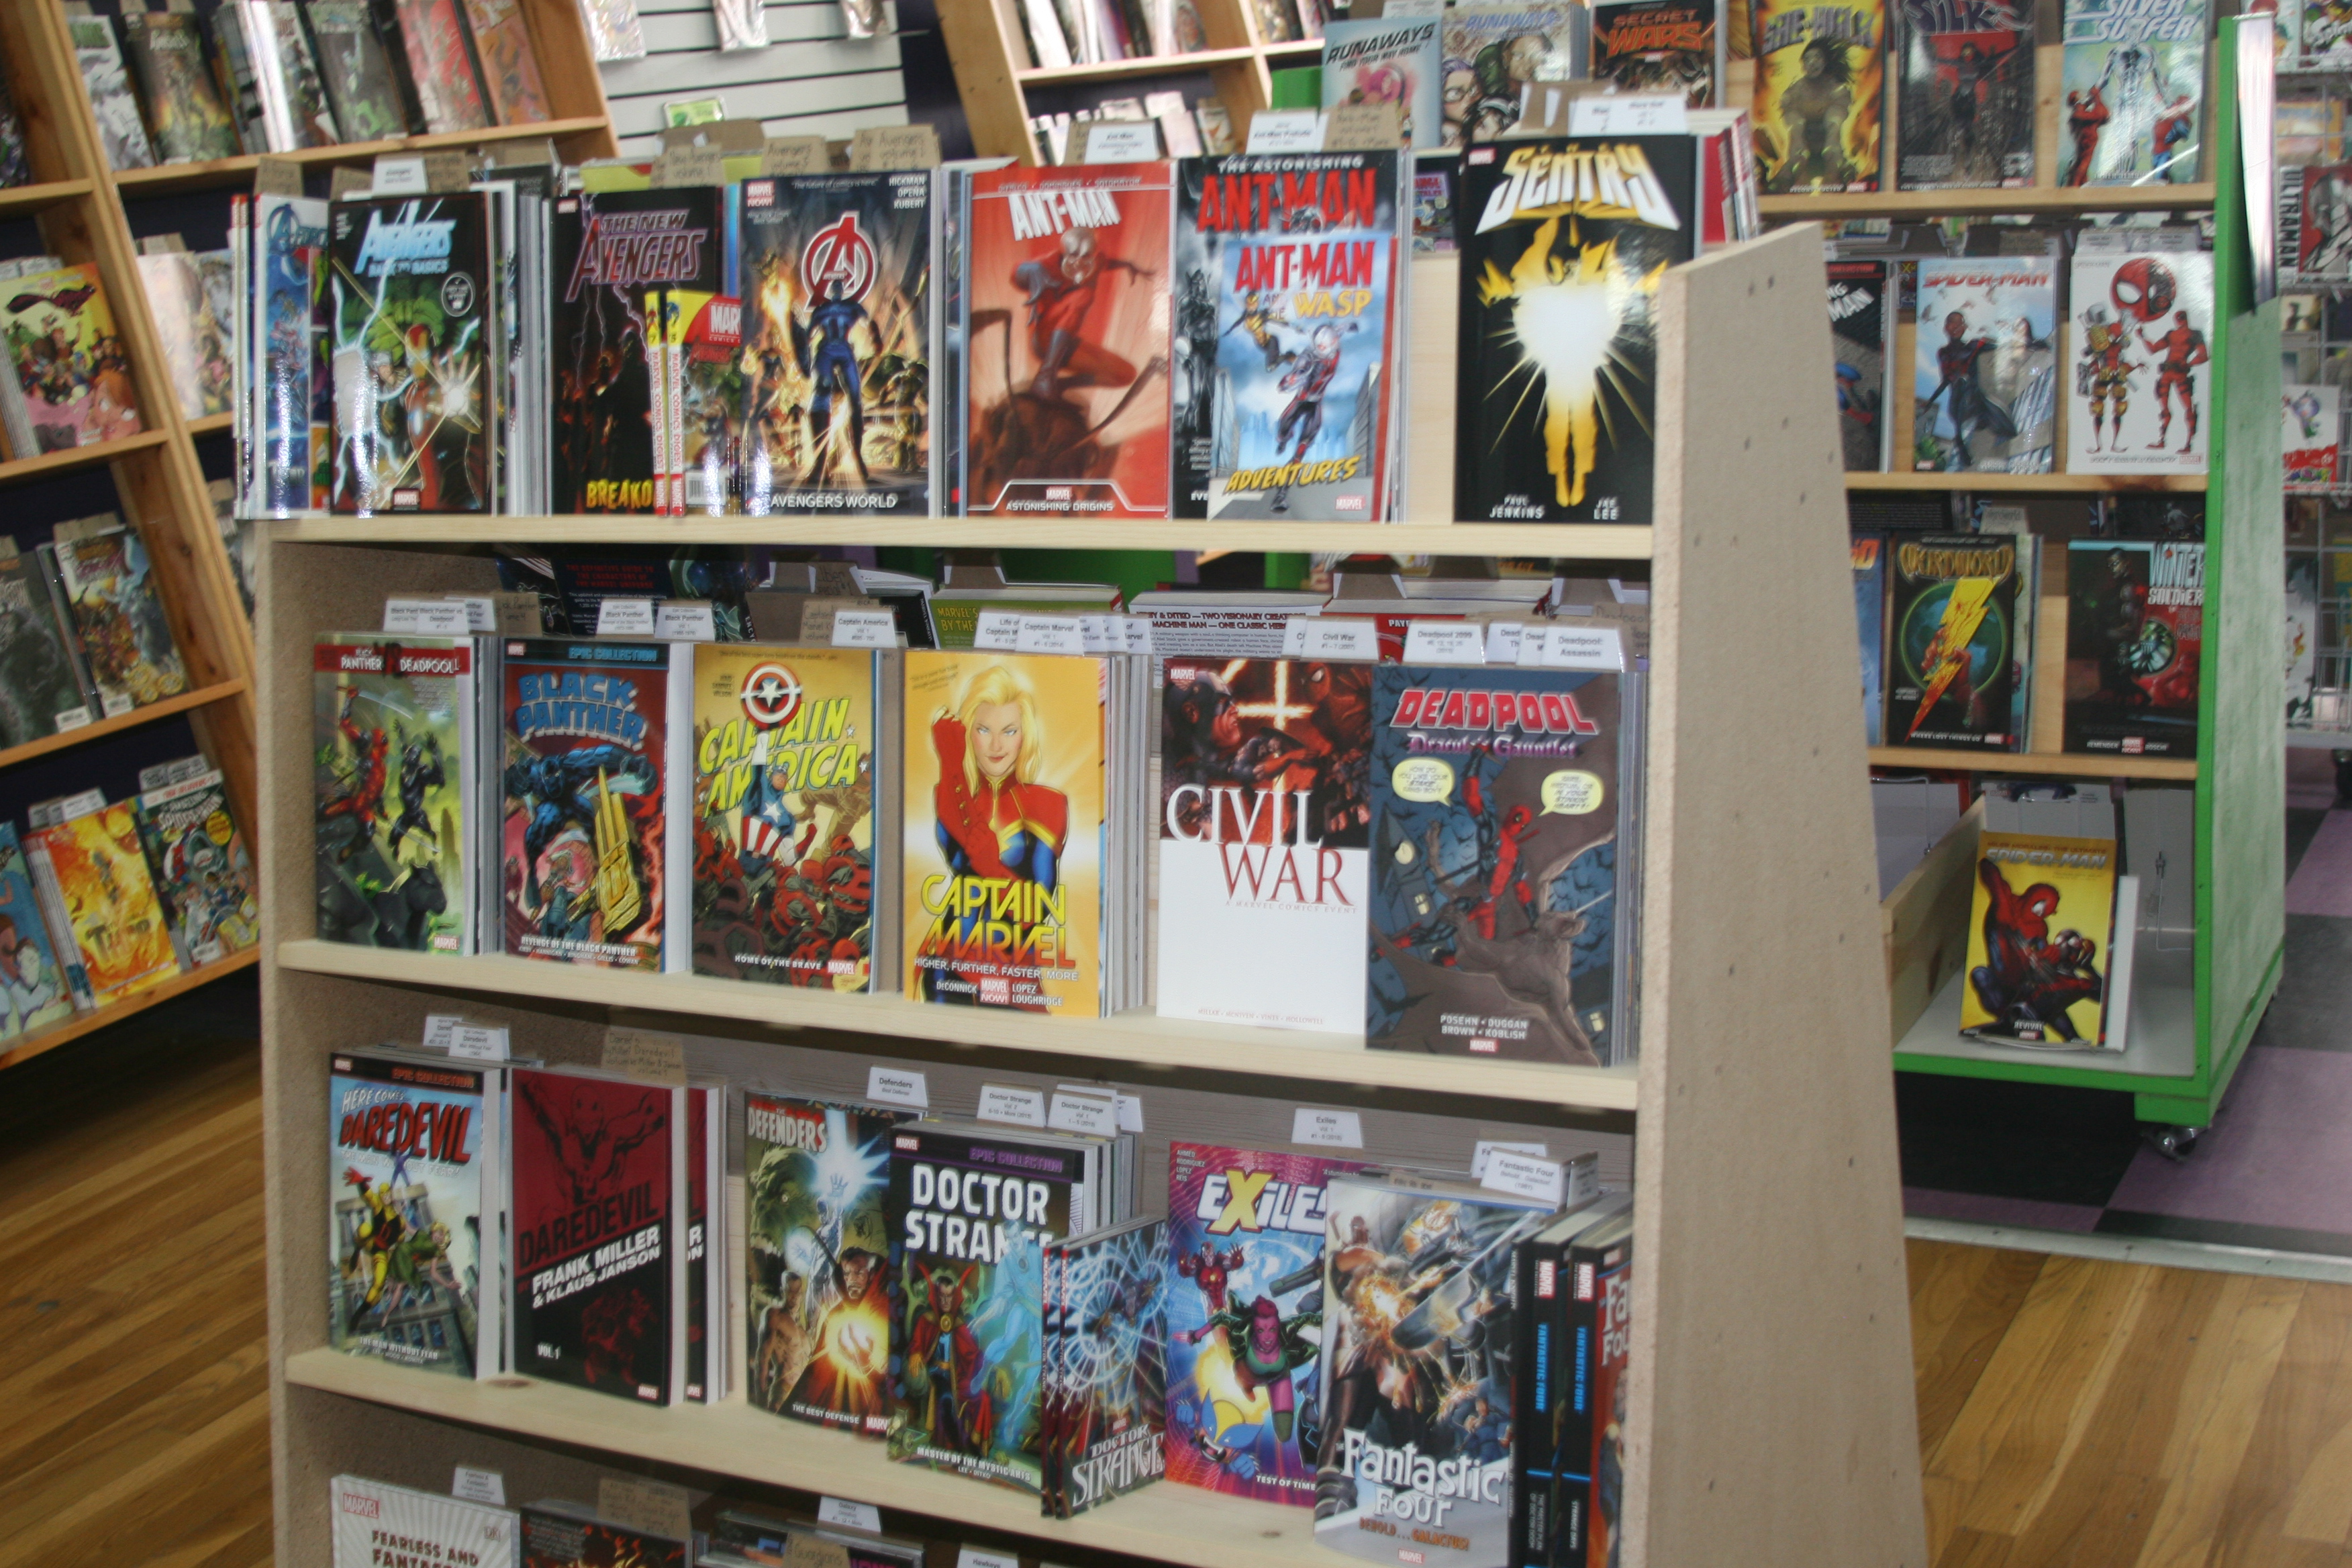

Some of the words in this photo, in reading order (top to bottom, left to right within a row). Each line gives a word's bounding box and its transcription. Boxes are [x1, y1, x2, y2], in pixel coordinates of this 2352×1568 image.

[1613, 9, 1698, 27] SECRET
[1606, 21, 1704, 59] WARS
[2081, 15, 2198, 44] SURFER
[1326, 21, 1436, 64] RUNAWAYS
[1218, 158, 1251, 175] THE
[1251, 153, 1365, 173] ASTONISHING
[889, 173, 927, 187] HICKMAN
[1473, 142, 1681, 236] SENTRY
[893, 197, 926, 209] KUBERT
[1195, 168, 1377, 233] ANT-MAN
[603, 214, 638, 233] THE
[639, 209, 689, 232] NEW
[1008, 188, 1122, 242] ANT-MAN
[566, 213, 709, 303] AVENGERS
[1233, 240, 1376, 294] ANT-MAN
[1922, 271, 2051, 289] SPIDER-MAN
[1292, 289, 1373, 320] WASP
[1224, 454, 1363, 495] ADVENTURES
[587, 477, 654, 509] BREAKO
[770, 494, 843, 508] AVENGERS
[844, 493, 897, 509] WORLD
[1504, 493, 1530, 506] PAUL
[1006, 501, 1071, 512] ASTONISHING
[1073, 502, 1114, 512] ORIGINS
[1489, 504, 1545, 519] JENKINS
[1594, 506, 1620, 520] LEE
[2147, 587, 2204, 606] SOLDIER
[605, 611, 622, 619] Black
[622, 611, 644, 620] Panther
[682, 615, 705, 623] Panther
[838, 618, 862, 628] Captain
[863, 619, 889, 627] America
[1152, 621, 1188, 629] MACHINE
[1167, 611, 1191, 620] DITKO
[1024, 623, 1050, 632] Captain
[1052, 623, 1074, 632] Marvel
[1322, 632, 1338, 641] Civil
[1340, 633, 1355, 641] War
[1417, 630, 1455, 640] Deadpool
[1557, 636, 1603, 646] Deadpool:
[341, 656, 383, 671] PANTHER
[1559, 649, 1602, 658] Assassin
[400, 656, 455, 674] DEADPOOL
[517, 671, 639, 712] BLACK
[1389, 687, 1600, 736] DEADPOOL
[514, 701, 649, 752] PANTHER
[1492, 734, 1578, 758] Gauntlet
[1166, 783, 1324, 848] CIVIL
[1986, 848, 2108, 871] SPIDER-MAN
[1215, 840, 1355, 906] WAR
[921, 875, 1067, 926] CAPTAIN
[1236, 901, 1274, 910] MARVEL
[1278, 903, 1320, 912] COMICS
[1324, 905, 1358, 914] EVENT
[521, 935, 550, 948] REVENGE
[550, 938, 560, 948] OF
[561, 939, 575, 950] THE
[576, 941, 599, 954] BLACK
[601, 944, 637, 957] PANTHER
[916, 915, 1077, 971] MARVEL
[734, 954, 759, 966] HOME
[761, 957, 773, 967] OF
[774, 957, 791, 968] THE
[792, 959, 822, 971] BRAVE
[914, 957, 949, 973] HIGHER,
[951, 961, 999, 977] FURTHER,
[1001, 965, 1043, 979] FASTER,
[1046, 969, 1078, 982] MORE
[1012, 983, 1037, 995] LOPEZ
[1012, 993, 1063, 1007] LOUGHRIDGE
[1440, 1013, 1479, 1026] POSEHN
[1487, 1016, 1529, 1029] DUGGAN
[2014, 1018, 2043, 1031] REVIVAL
[1441, 1025, 1476, 1036] BROWN
[1485, 1028, 1527, 1040] KOBLISH
[879, 1076, 913, 1089] Defenders
[342, 1087, 373, 1114] HERE
[989, 1092, 1009, 1103] Doctor
[1010, 1095, 1032, 1106] Strange
[1061, 1101, 1081, 1111] Doctor
[1081, 1105, 1104, 1115] Strange
[748, 1106, 827, 1153] DEFENDERS
[1315, 1116, 1336, 1125] Exiles
[338, 1101, 474, 1167] DAREDEVIL
[969, 1146, 995, 1161] EPIC
[997, 1150, 1064, 1173] COLLECTION
[1176, 1149, 1196, 1159] AHMED
[1176, 1166, 1193, 1175] LOPEZ
[1499, 1160, 1534, 1174] Fantastic
[1535, 1167, 1555, 1178] Four
[911, 1162, 1051, 1226] DOCTOR
[518, 1181, 660, 1271] DAREDEVIL
[903, 1208, 1055, 1267] STRAN
[532, 1254, 590, 1294] FRANK
[594, 1224, 661, 1268] MILLER
[532, 1293, 544, 1309] &
[545, 1272, 595, 1304] KLAUS
[598, 1244, 661, 1284] JANSON
[1538, 1260, 1555, 1297] MARVEL
[1577, 1262, 1595, 1301] MARVEL
[360, 1336, 371, 1346] THE
[373, 1338, 388, 1349] MAN
[388, 1342, 421, 1356] WITHOUT
[421, 1349, 438, 1360] FEAR
[792, 1403, 805, 1414] THE
[805, 1406, 825, 1418] BEST
[826, 1410, 860, 1424] DEFENSE
[1090, 1422, 1150, 1458] DOCTOR
[917, 1446, 950, 1463] MASTER
[951, 1453, 961, 1464] OF
[963, 1455, 978, 1468] THE
[978, 1459, 1009, 1475] MYSTIC
[1009, 1467, 1032, 1481] ARTS
[1072, 1430, 1165, 1508] STRANGE
[1342, 1427, 1508, 1506] Fantastic
[1256, 1474, 1278, 1485] TEST
[1278, 1477, 1292, 1487] OF
[1293, 1479, 1316, 1491] TIME
[343, 1493, 379, 1518] MARVEL
[372, 1530, 442, 1559] FEARLESS
[448, 1548, 479, 1567] AND
